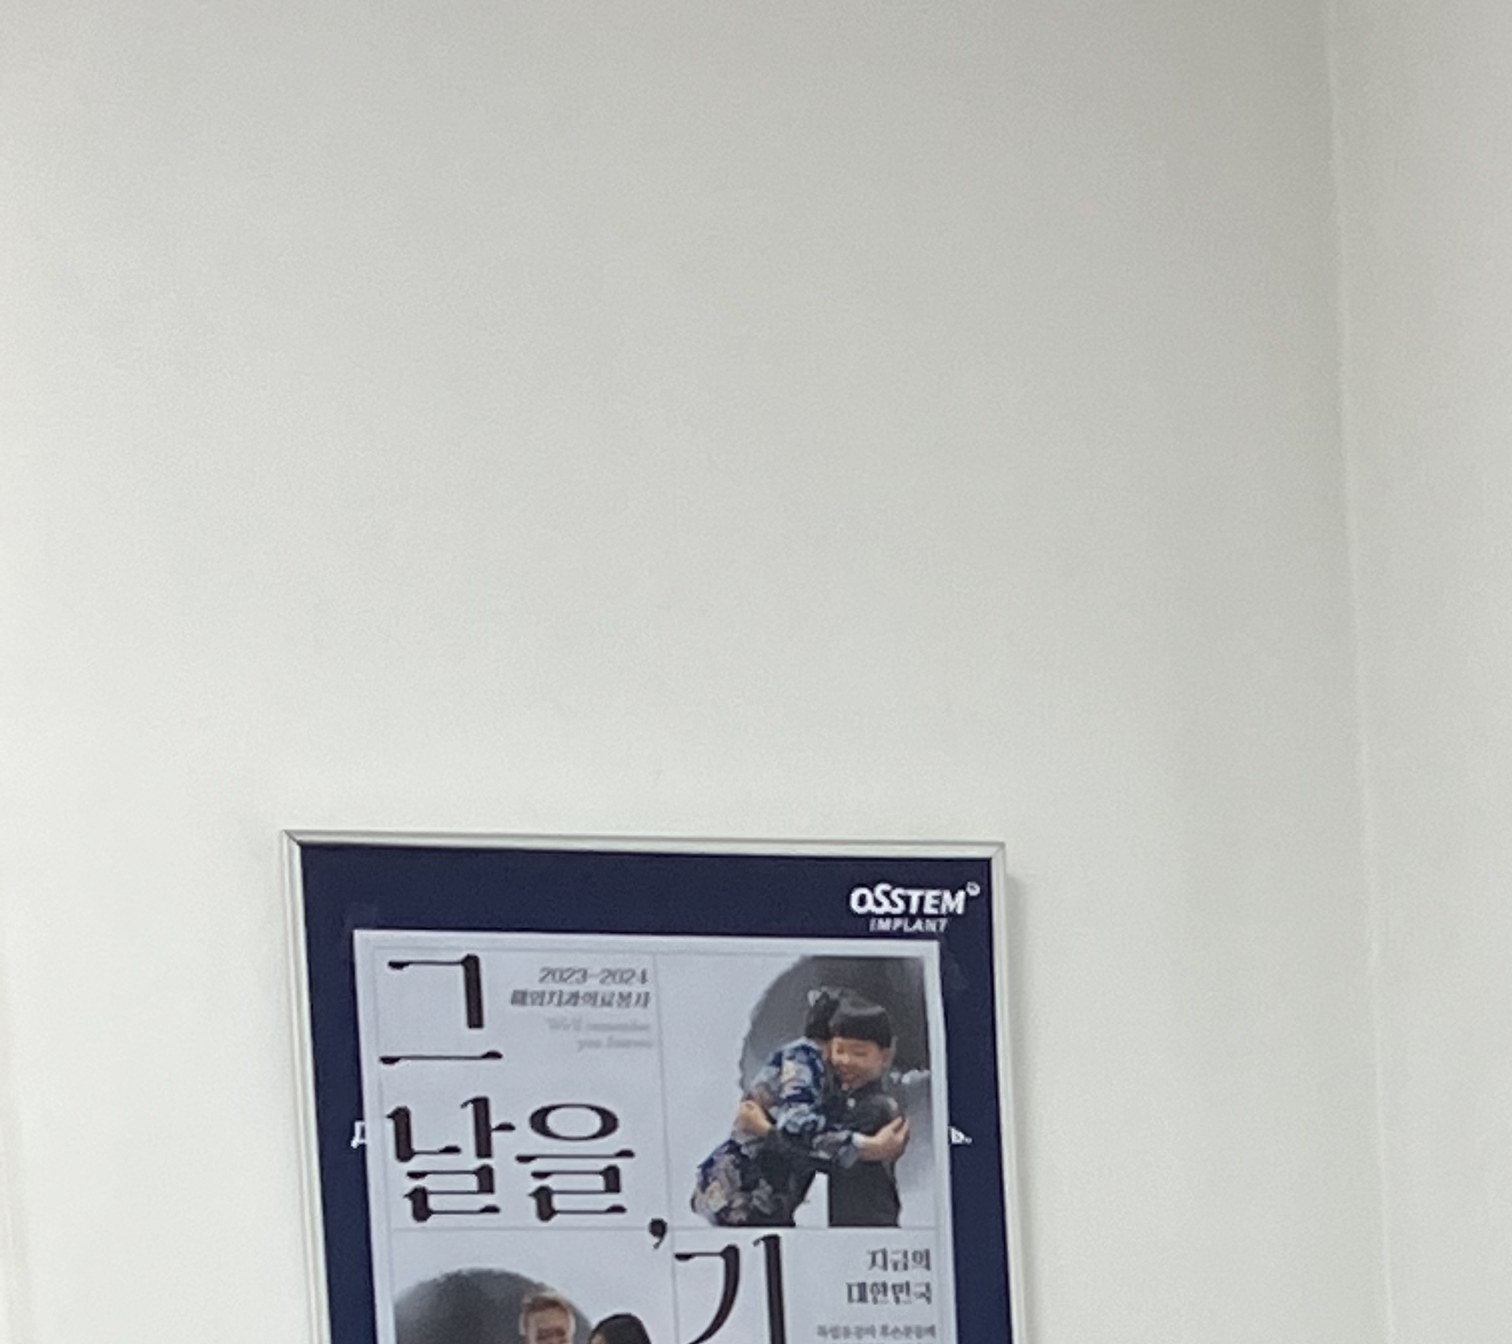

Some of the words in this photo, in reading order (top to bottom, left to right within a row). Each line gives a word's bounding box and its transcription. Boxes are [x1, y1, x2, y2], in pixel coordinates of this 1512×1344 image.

[869, 917, 949, 933] IMPLANT
[379, 954, 503, 1065] 그
[384, 1096, 668, 1249] 날을,
[866, 1248, 932, 1272] 지금의
[846, 1280, 933, 1305] 대한민국
